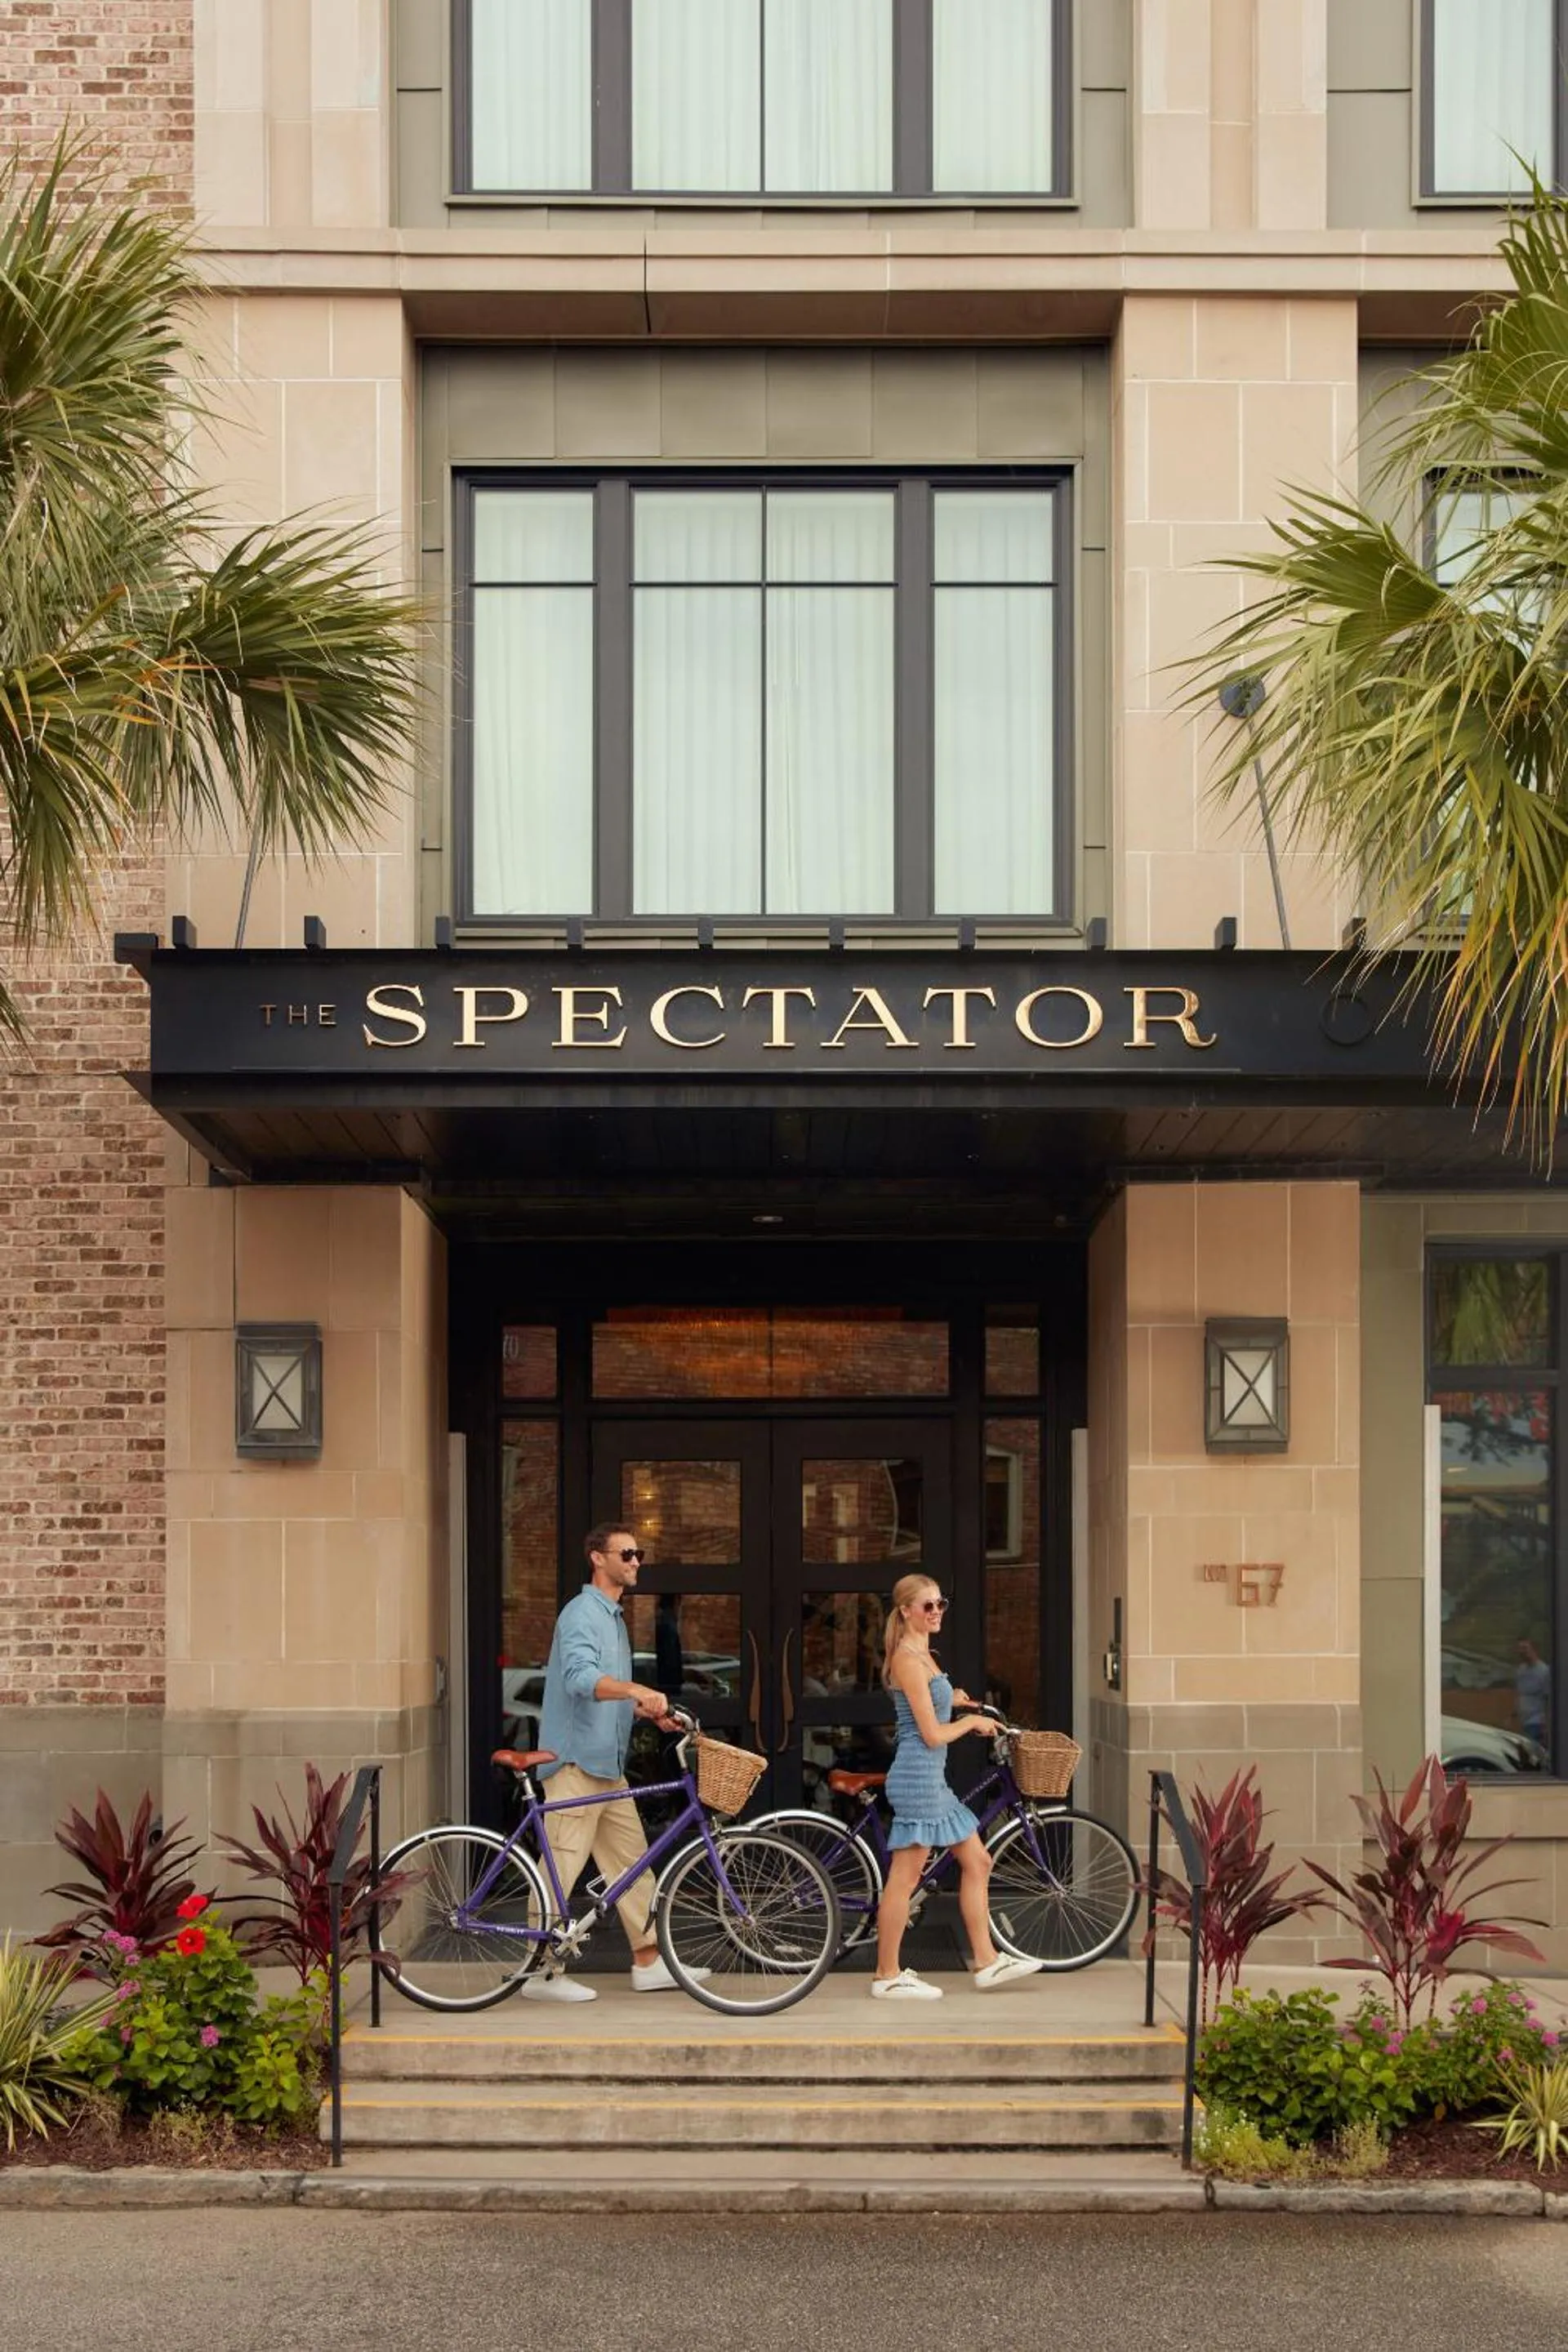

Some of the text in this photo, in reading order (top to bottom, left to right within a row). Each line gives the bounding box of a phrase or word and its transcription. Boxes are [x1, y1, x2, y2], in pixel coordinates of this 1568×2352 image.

[260, 984, 1217, 1047] THE SPECTATOR
[1236, 1563, 1285, 1606] 67
